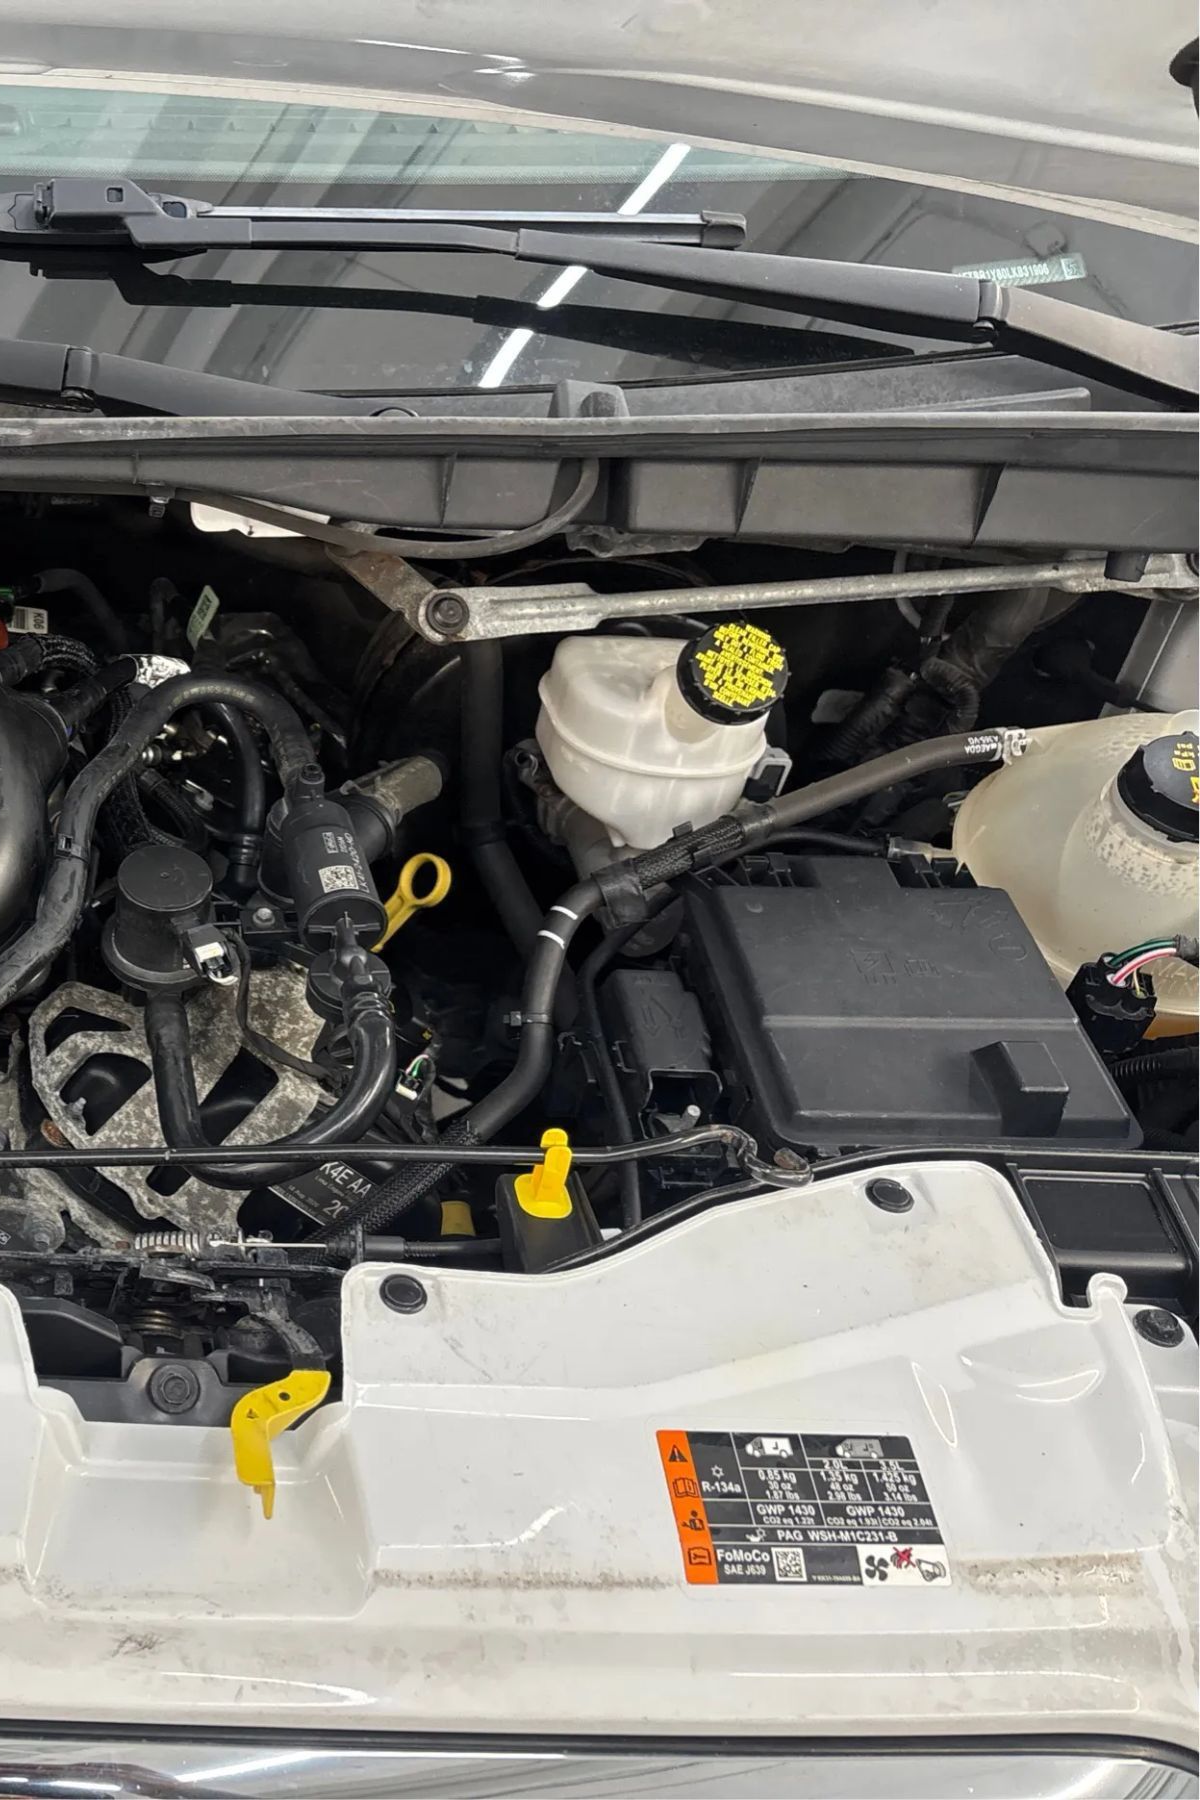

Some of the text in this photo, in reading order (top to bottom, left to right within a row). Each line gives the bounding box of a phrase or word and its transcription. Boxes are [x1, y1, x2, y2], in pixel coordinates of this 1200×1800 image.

[822, 1459, 848, 1470] 2.0L
[879, 1460, 904, 1471] 3.5L
[783, 1470, 797, 1483] kg
[820, 1470, 859, 1485] 1.35 kg
[901, 1472, 917, 1486] kg
[701, 1481, 742, 1493] R-134a
[756, 1504, 815, 1516] GWP 1430
[846, 1505, 905, 1517] GWP 1430
[763, 1516, 781, 1525] CO2
[827, 1517, 845, 1525] CO2
[882, 1517, 900, 1526] CO2
[777, 1530, 898, 1542] PAG WSH-M1C231-B
[717, 1550, 770, 1562] FoMoCo
[724, 1565, 766, 1576] SAE J639
